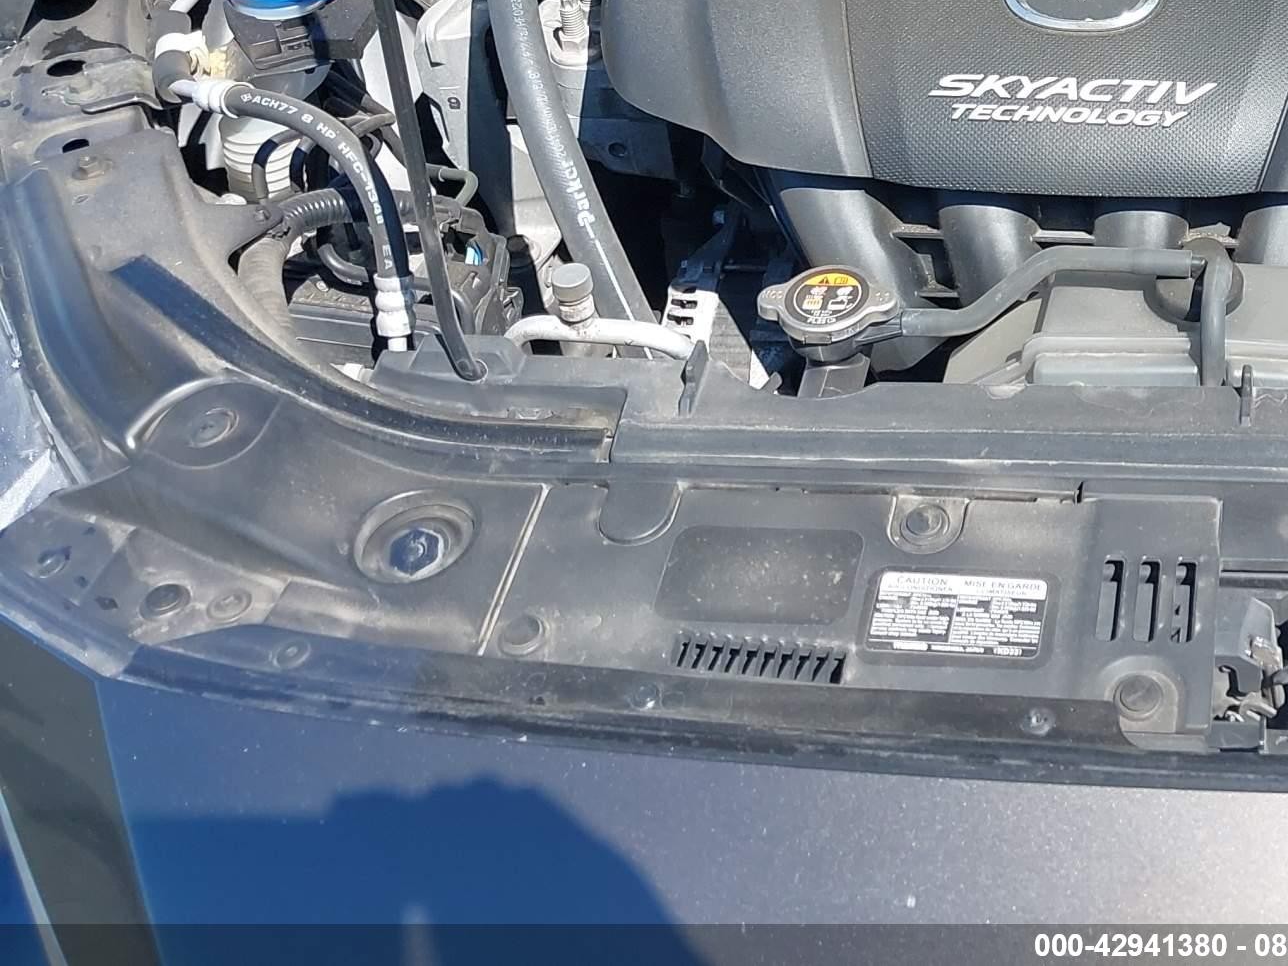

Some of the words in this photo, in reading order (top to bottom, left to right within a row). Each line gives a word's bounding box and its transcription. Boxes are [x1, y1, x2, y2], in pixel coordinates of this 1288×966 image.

[928, 74, 1218, 105] SKYACTIV
[951, 103, 1190, 128] TECHNOLOGY
[251, 94, 297, 116] ACH77
[300, 112, 314, 125] 8
[316, 120, 338, 141] HP
[380, 244, 393, 270] EA
[563, 163, 595, 228] Parker
[897, 576, 948, 587] CAUTION
